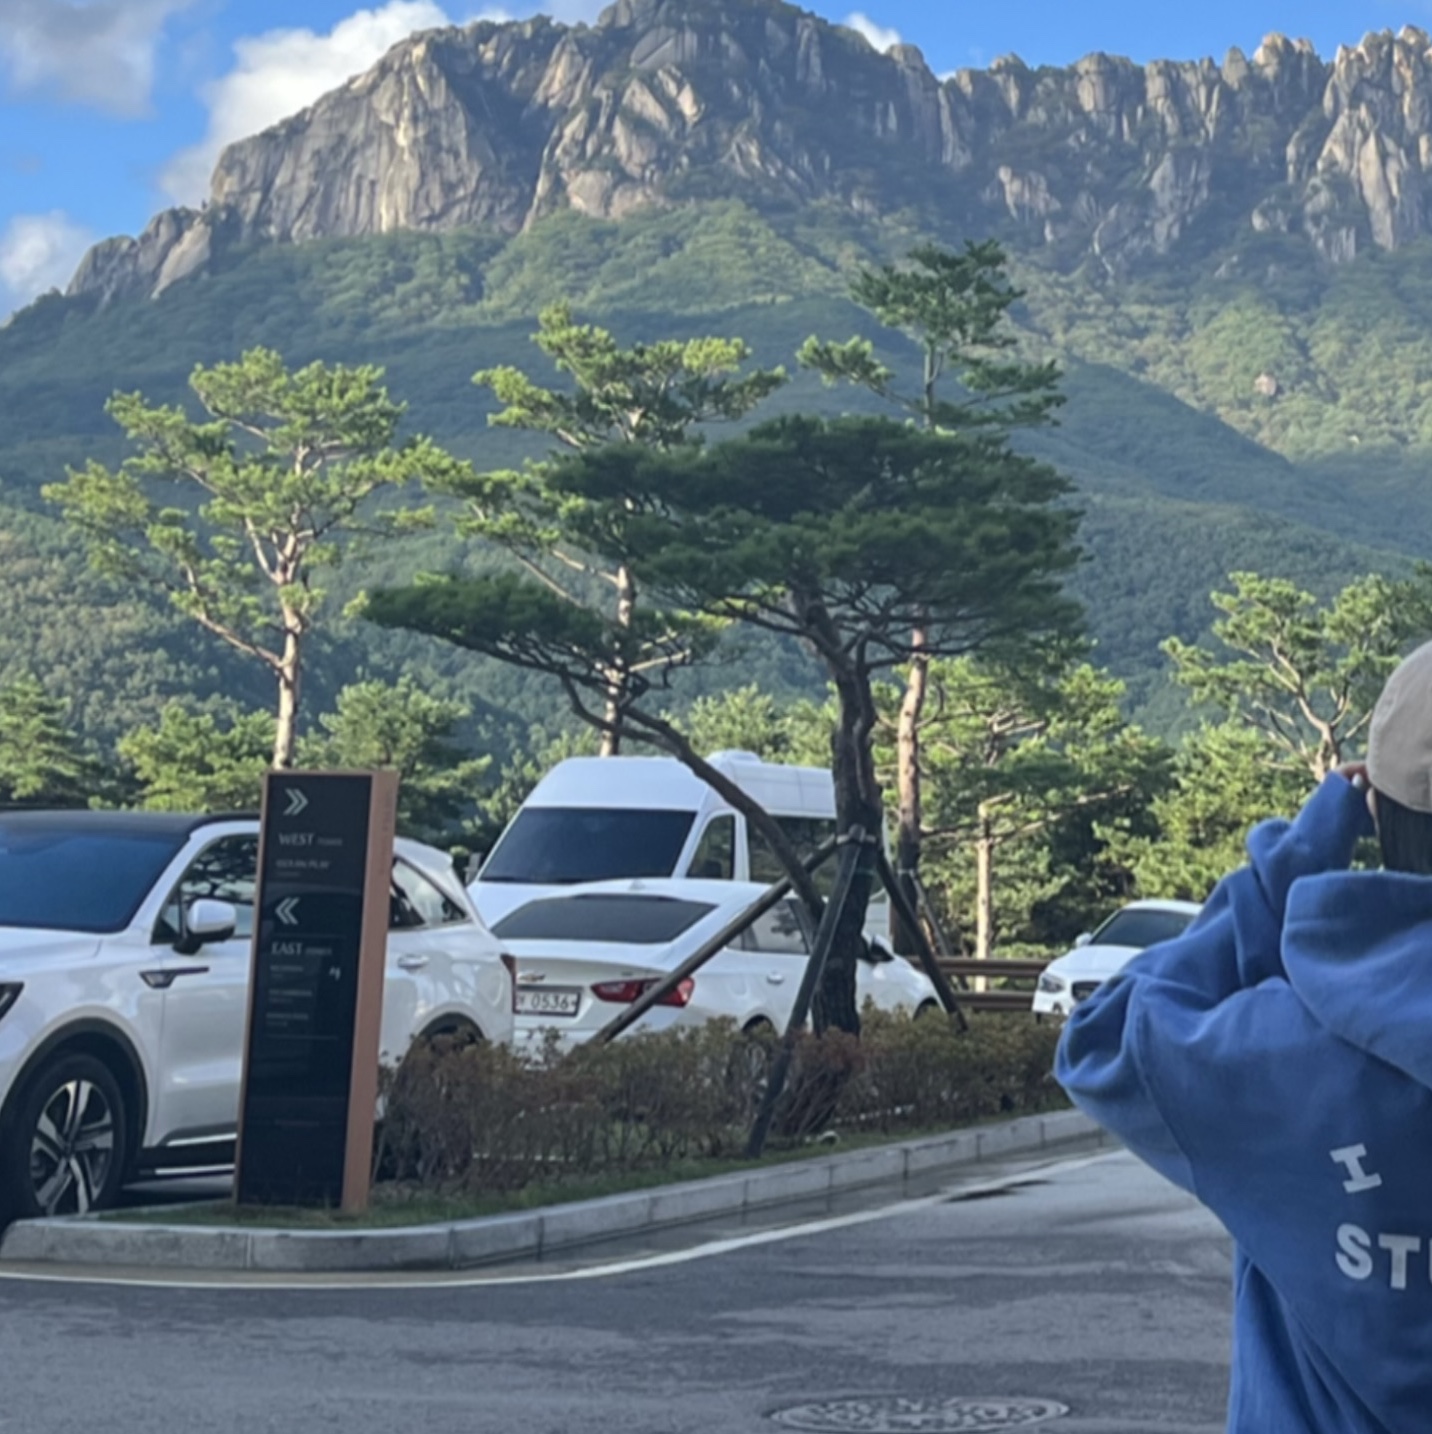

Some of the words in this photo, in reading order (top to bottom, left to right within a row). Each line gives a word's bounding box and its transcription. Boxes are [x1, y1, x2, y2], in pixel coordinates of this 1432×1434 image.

[278, 832, 315, 846] WEST
[271, 942, 303, 955] EAST
[530, 993, 569, 1010] 0536
[1330, 1143, 1382, 1193] I
